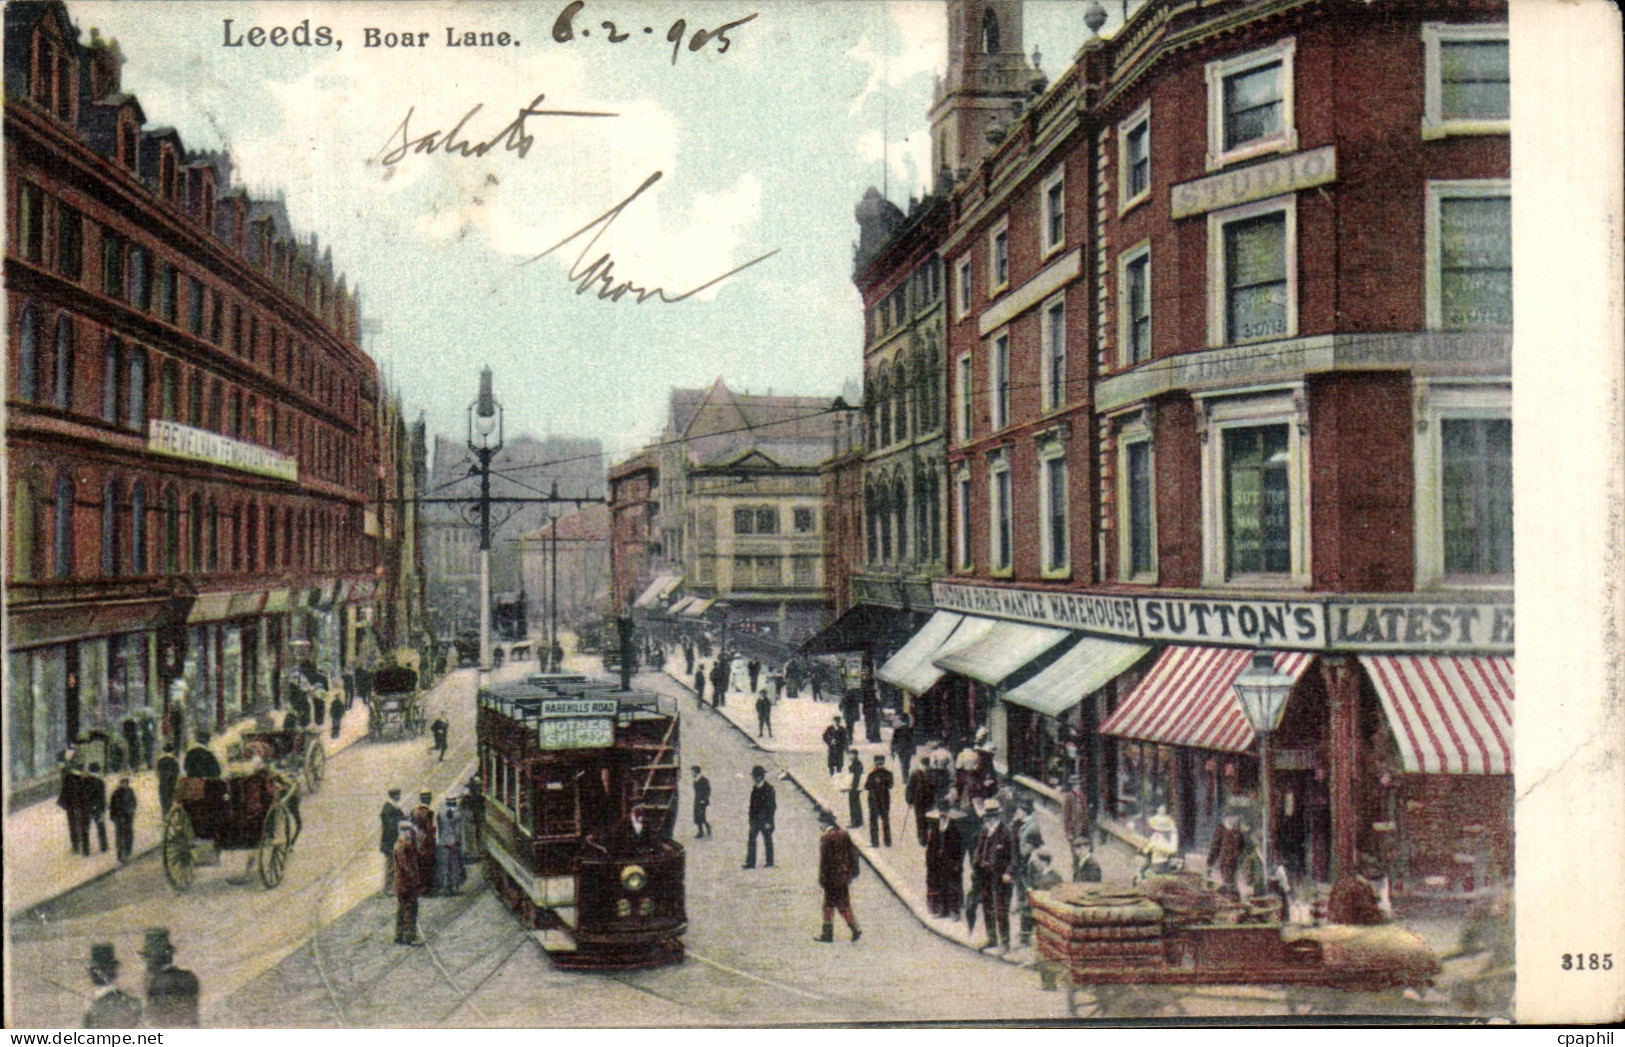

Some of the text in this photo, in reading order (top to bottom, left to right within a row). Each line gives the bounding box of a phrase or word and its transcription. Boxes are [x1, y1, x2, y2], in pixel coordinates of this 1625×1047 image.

[222, 18, 521, 52] Leeds, Boar Lane.
[1178, 152, 1326, 204] STUDIO
[974, 588, 1003, 613] PARIS
[1003, 592, 1046, 620] MANTLE
[1049, 595, 1136, 632] WAREHOUSE
[1149, 602, 1317, 642] SUTTON'S
[1337, 606, 1478, 642] LATEST
[545, 703, 615, 713] HAREHILLS ROAD
[1561, 953, 1613, 971] 3185
